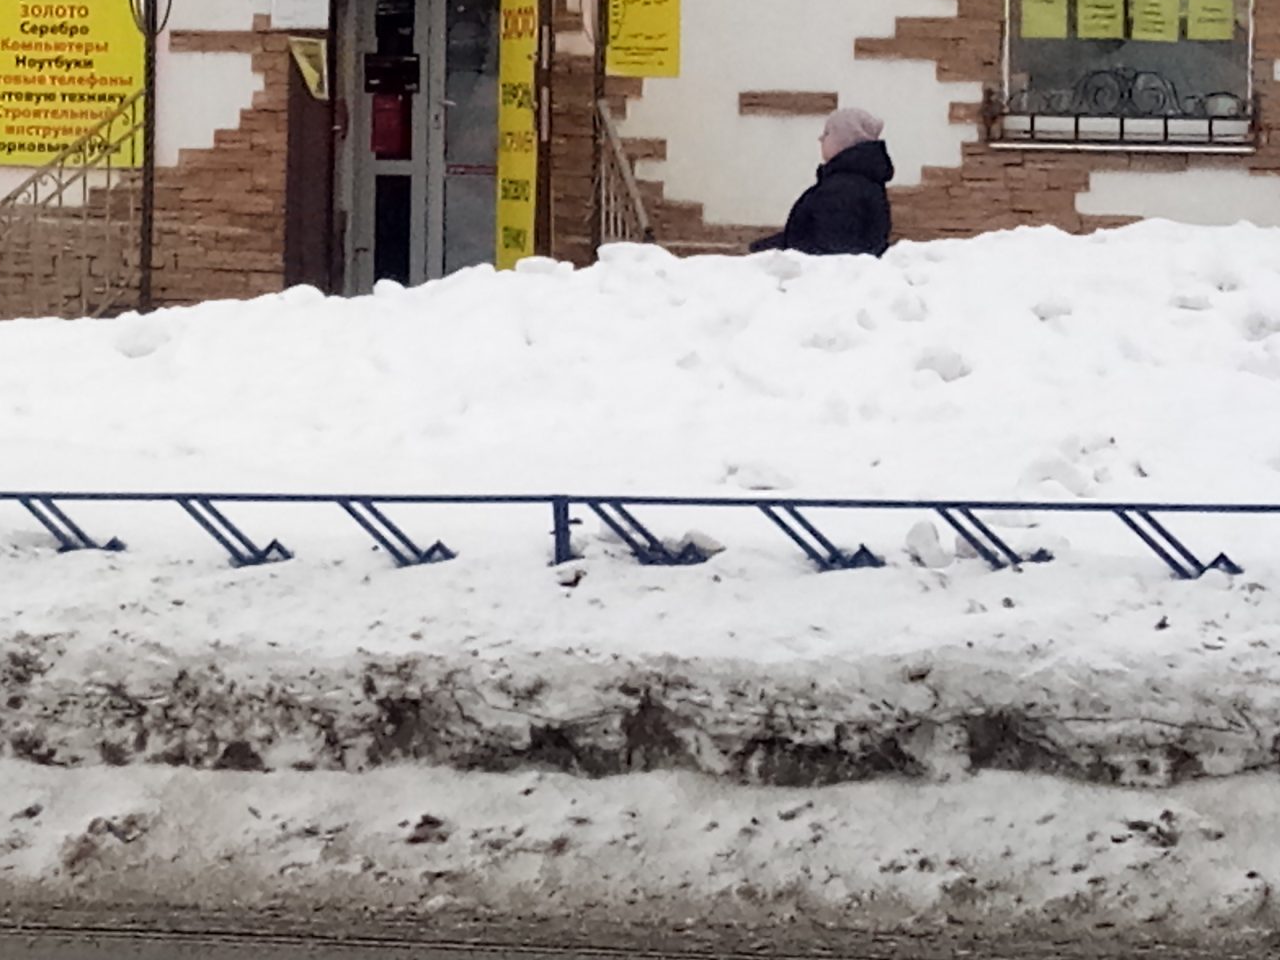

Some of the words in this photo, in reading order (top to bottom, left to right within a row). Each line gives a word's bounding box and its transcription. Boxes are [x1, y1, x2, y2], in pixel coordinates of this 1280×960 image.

[20, 4, 90, 19] ЗОЛОТО
[19, 20, 90, 37] Серебро
[0, 37, 109, 56] Компьютеры
[15, 55, 94, 72] Ноутбуки
[49, 71, 133, 88] телефоны
